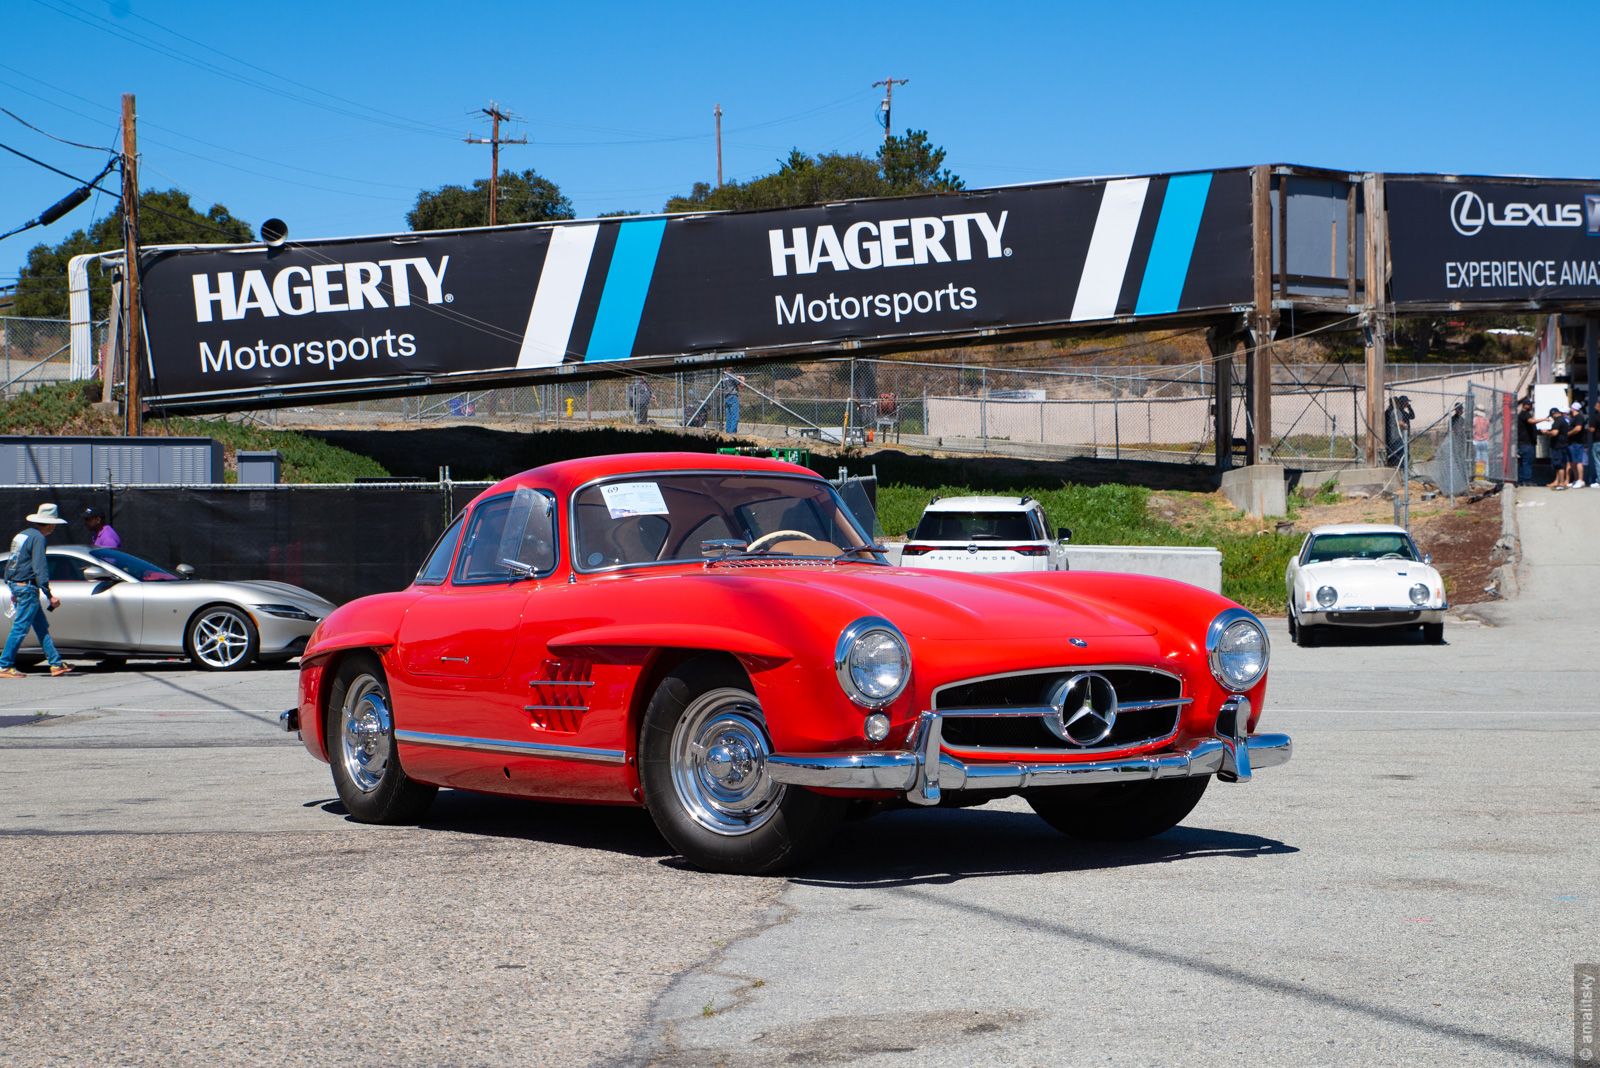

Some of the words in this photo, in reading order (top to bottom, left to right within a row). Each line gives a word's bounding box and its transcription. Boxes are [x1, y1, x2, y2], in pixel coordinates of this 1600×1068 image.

[1487, 202, 1583, 227] LEXUS
[1445, 260, 1557, 289] EXPERIENCE
[1559, 260, 1600, 286] AMA
[774, 283, 978, 326] Motorsports
[199, 329, 418, 374] Motorsports
[607, 486, 619, 494] 69
